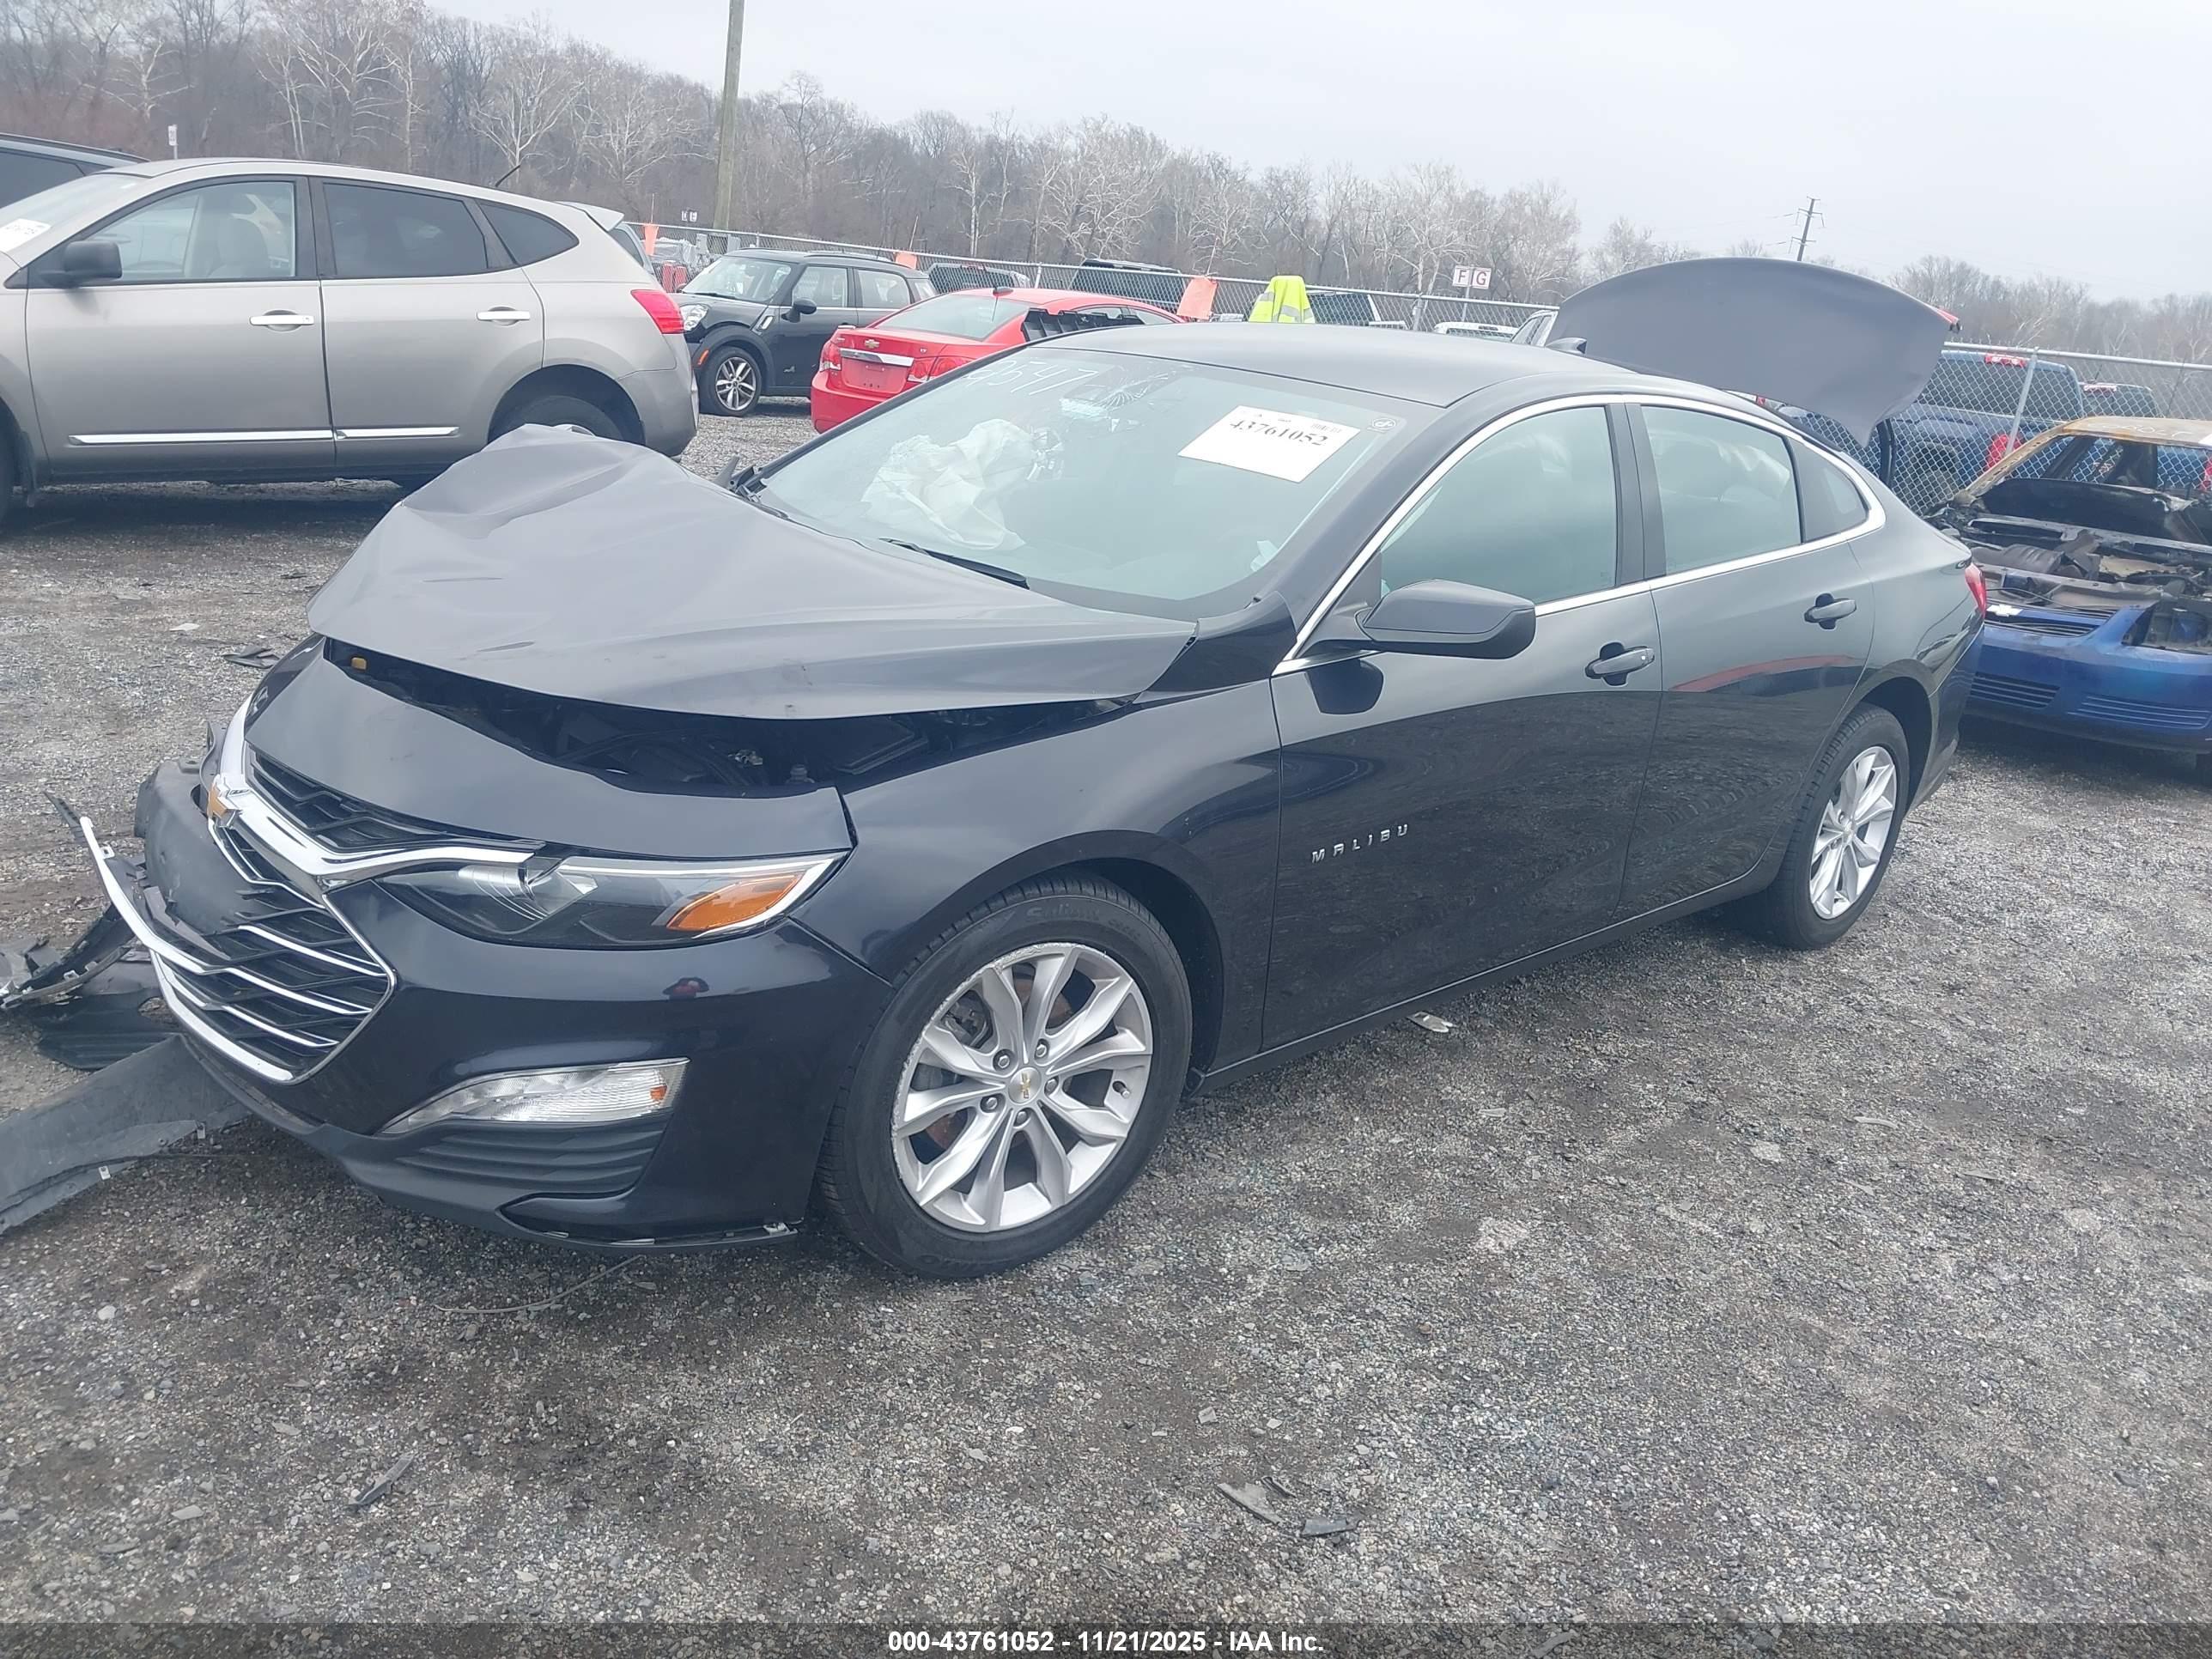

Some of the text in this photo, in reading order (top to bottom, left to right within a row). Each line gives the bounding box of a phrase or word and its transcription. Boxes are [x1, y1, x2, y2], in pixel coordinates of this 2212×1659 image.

[1457, 270, 1467, 283] F
[1476, 270, 1487, 286] G
[1229, 419, 1328, 447] 43761052
[1310, 823, 1409, 864] MALIBU
